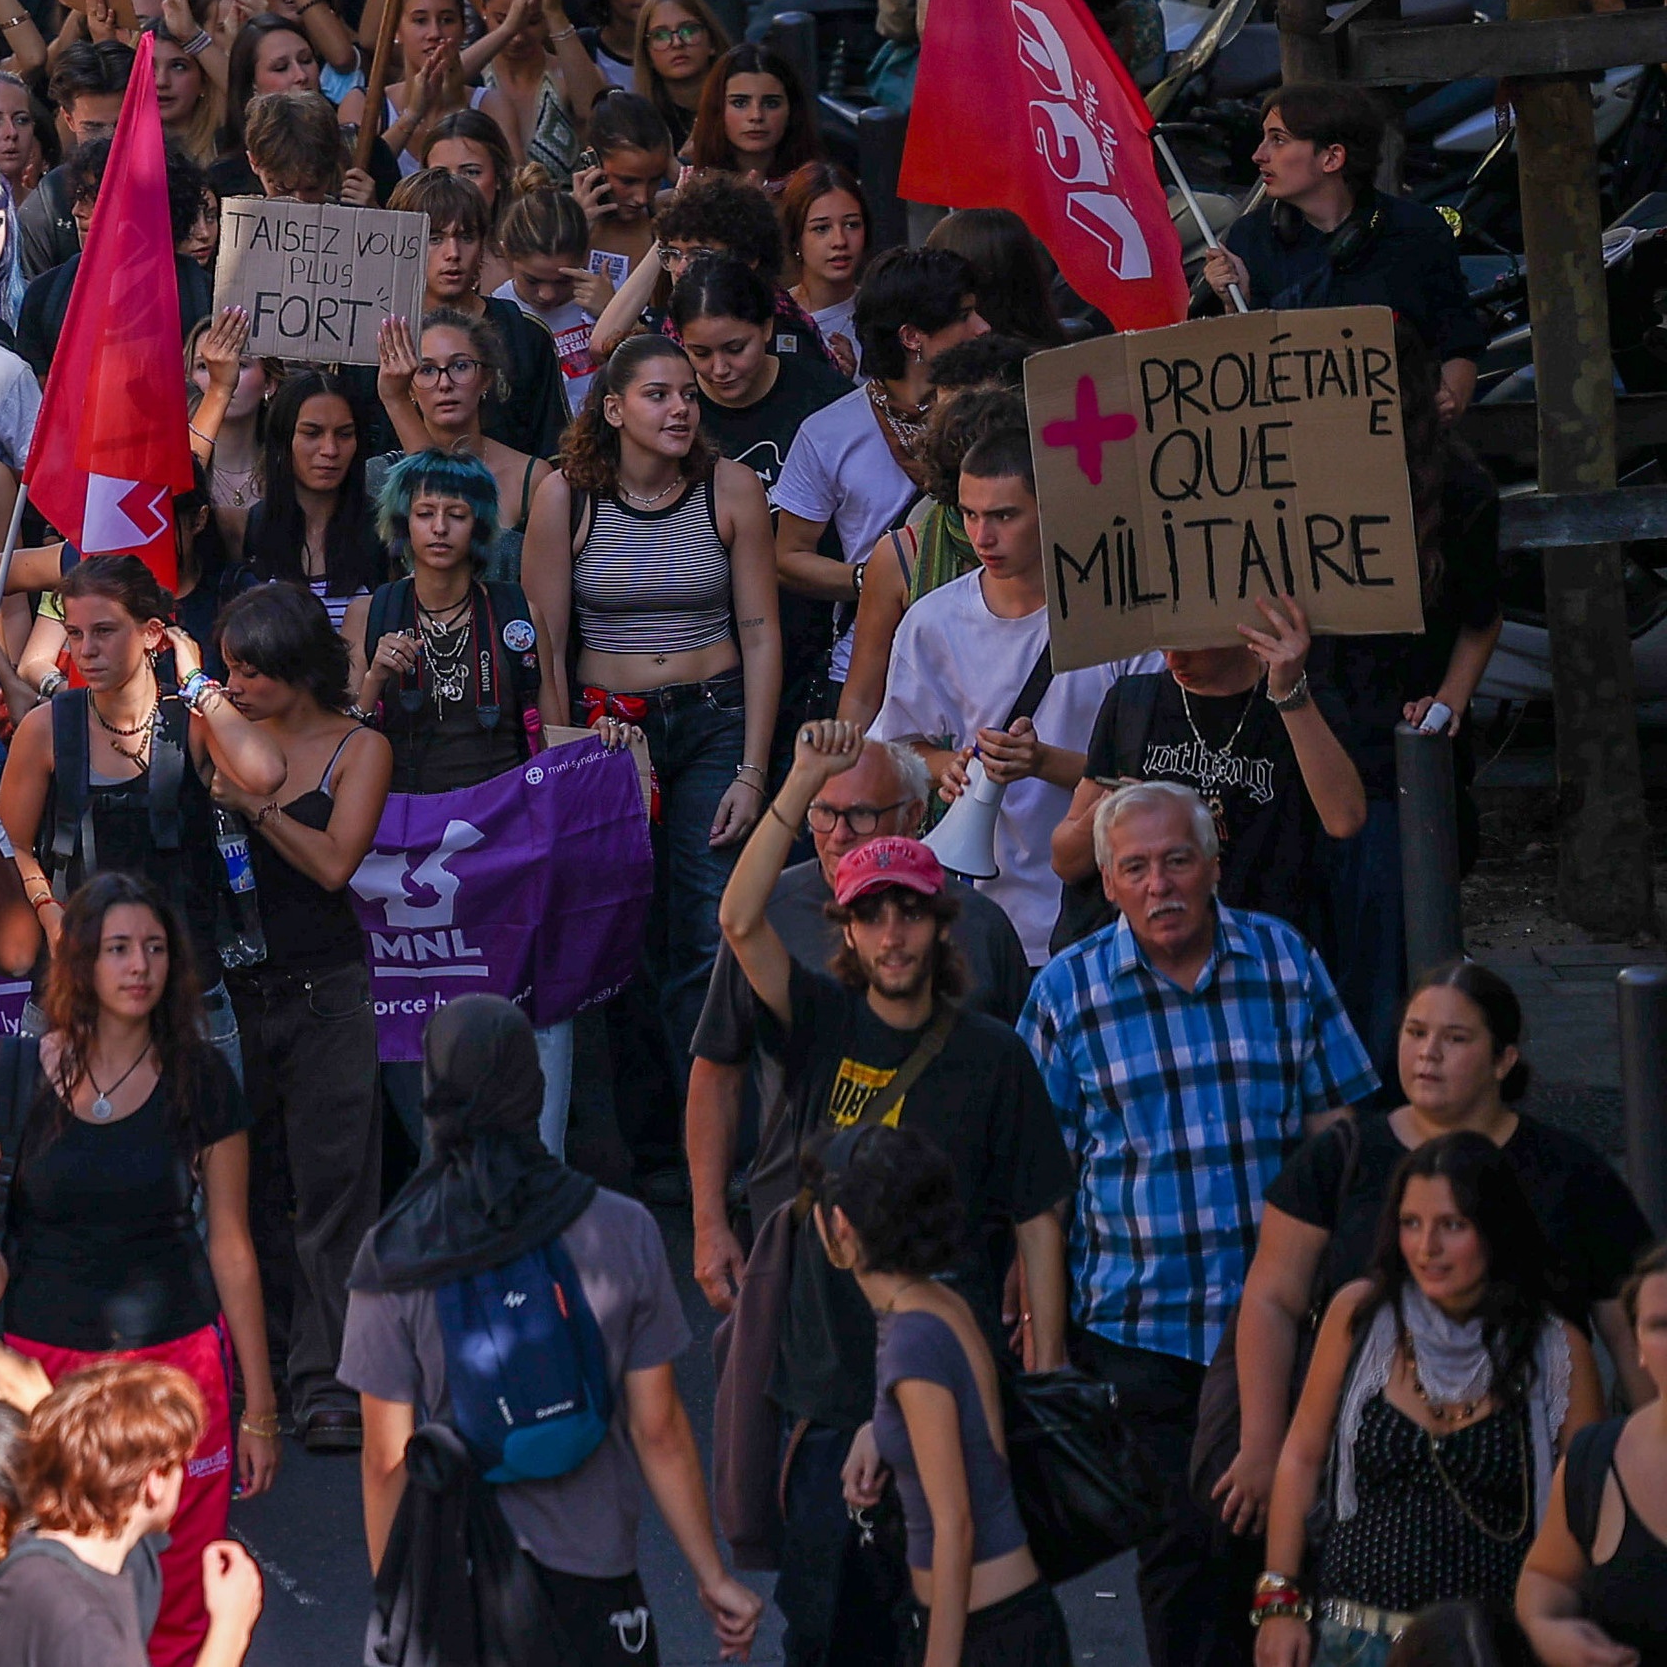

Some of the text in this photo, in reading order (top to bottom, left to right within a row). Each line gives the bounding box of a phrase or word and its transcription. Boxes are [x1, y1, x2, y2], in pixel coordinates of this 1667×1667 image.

[226, 211, 420, 260] TAISEZ VOUS
[290, 256, 353, 289] PLUS
[251, 291, 374, 348] FORT
[1149, 420, 1297, 502] QUE
[1053, 498, 1395, 621] MILITAIRE
[478, 649, 491, 693] Canon
[370, 928, 483, 961] MNL
